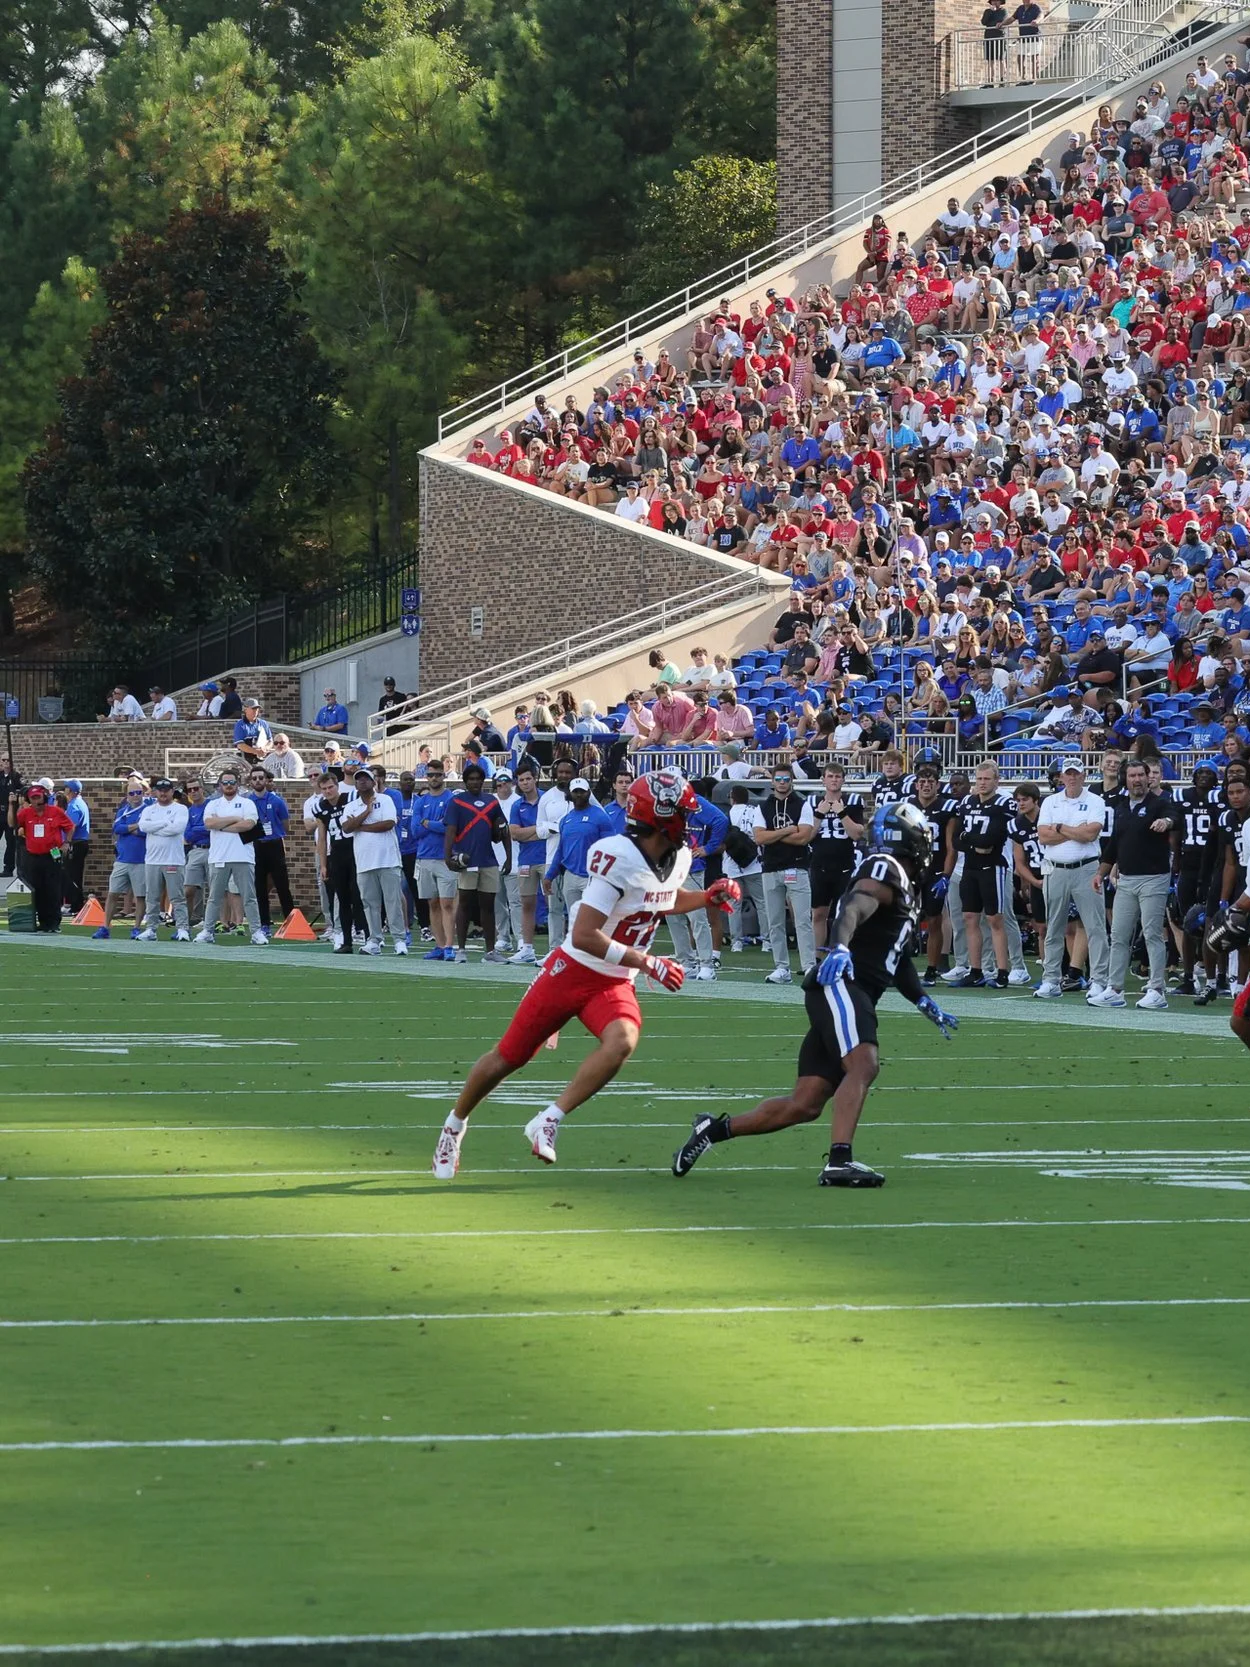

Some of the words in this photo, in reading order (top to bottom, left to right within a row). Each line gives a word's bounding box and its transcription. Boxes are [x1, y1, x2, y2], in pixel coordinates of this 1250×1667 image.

[1185, 814, 1211, 845] 19
[590, 850, 617, 876] 27
[871, 860, 888, 881] 0
[643, 891, 655, 904] NC
[655, 890, 674, 904] STATE
[611, 910, 660, 947] 27
